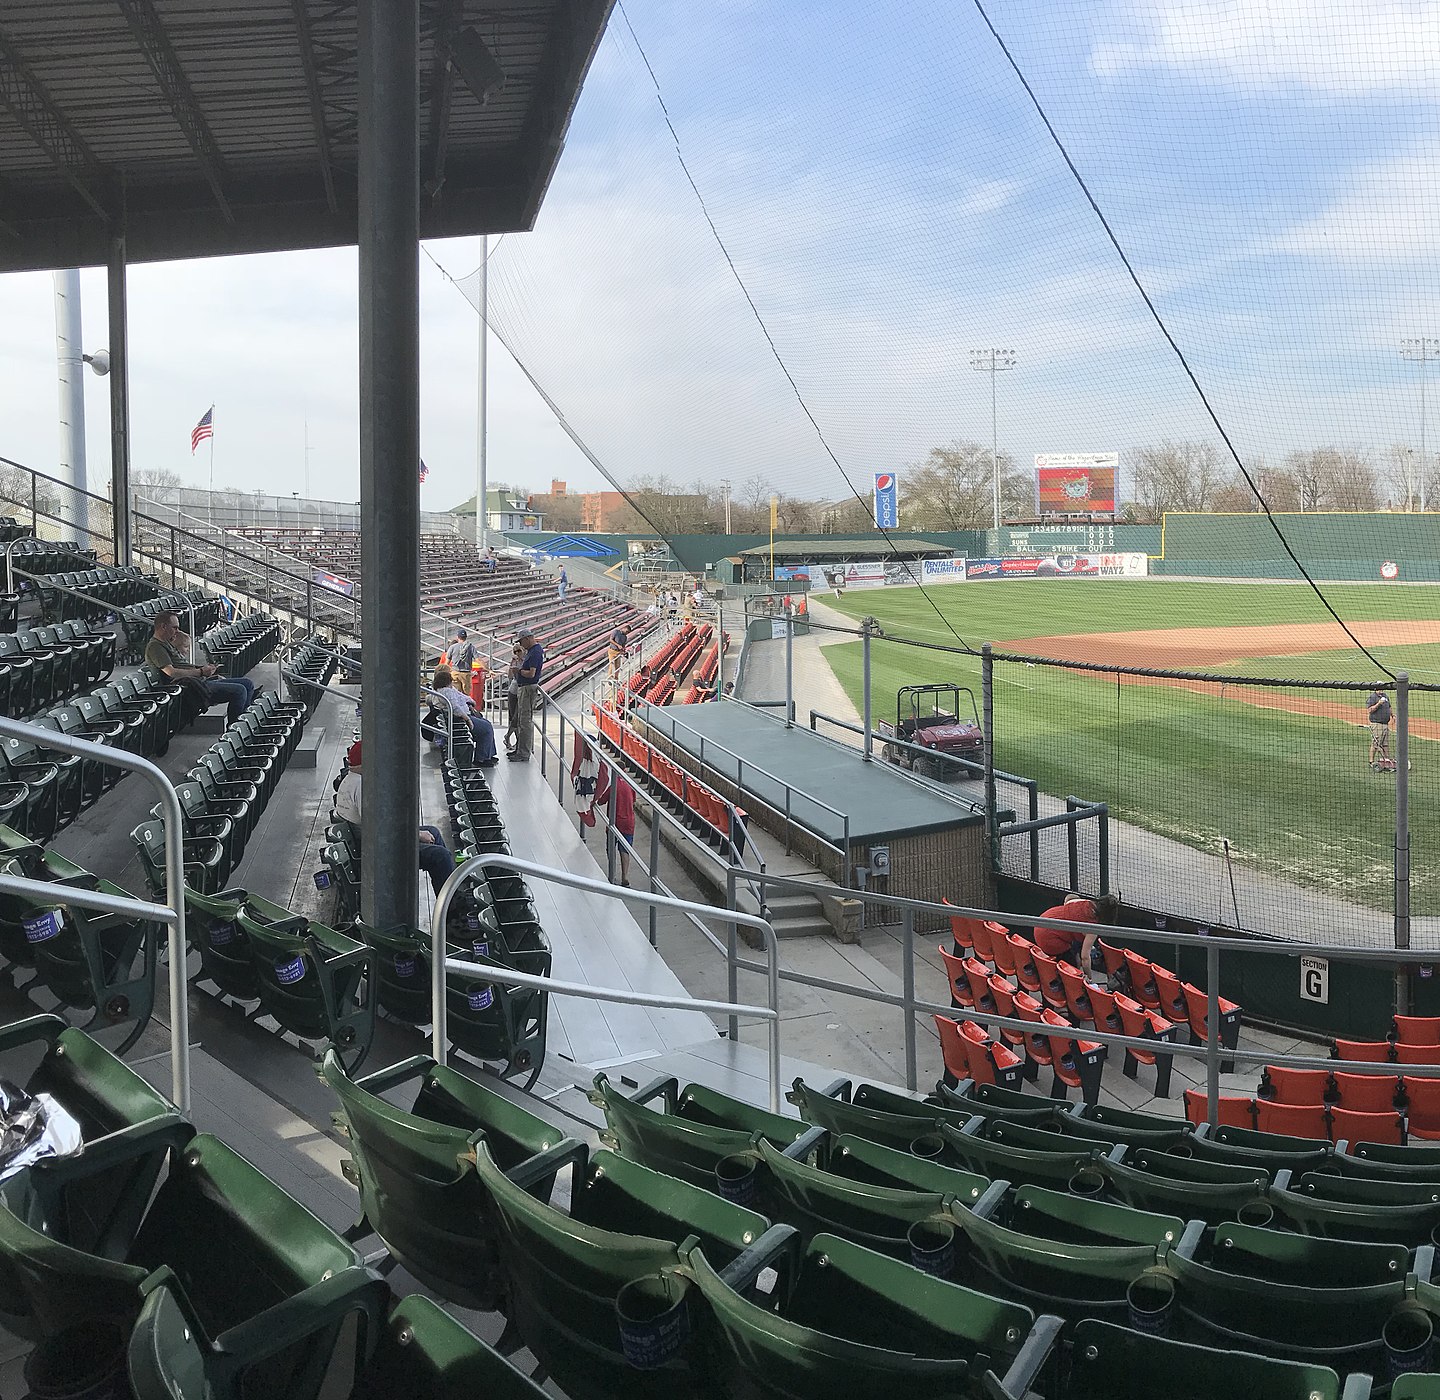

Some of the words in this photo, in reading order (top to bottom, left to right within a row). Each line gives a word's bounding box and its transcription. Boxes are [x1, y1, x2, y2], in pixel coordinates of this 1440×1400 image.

[880, 493, 892, 527] pepsi
[924, 560, 954, 568] RENTALS
[926, 566, 964, 574] UNLIMITED
[322, 580, 345, 593] GENERAL
[36, 918, 50, 927] Envy
[288, 962, 299, 970] Envy
[1302, 959, 1326, 971] SECTION
[1306, 970, 1321, 997] G
